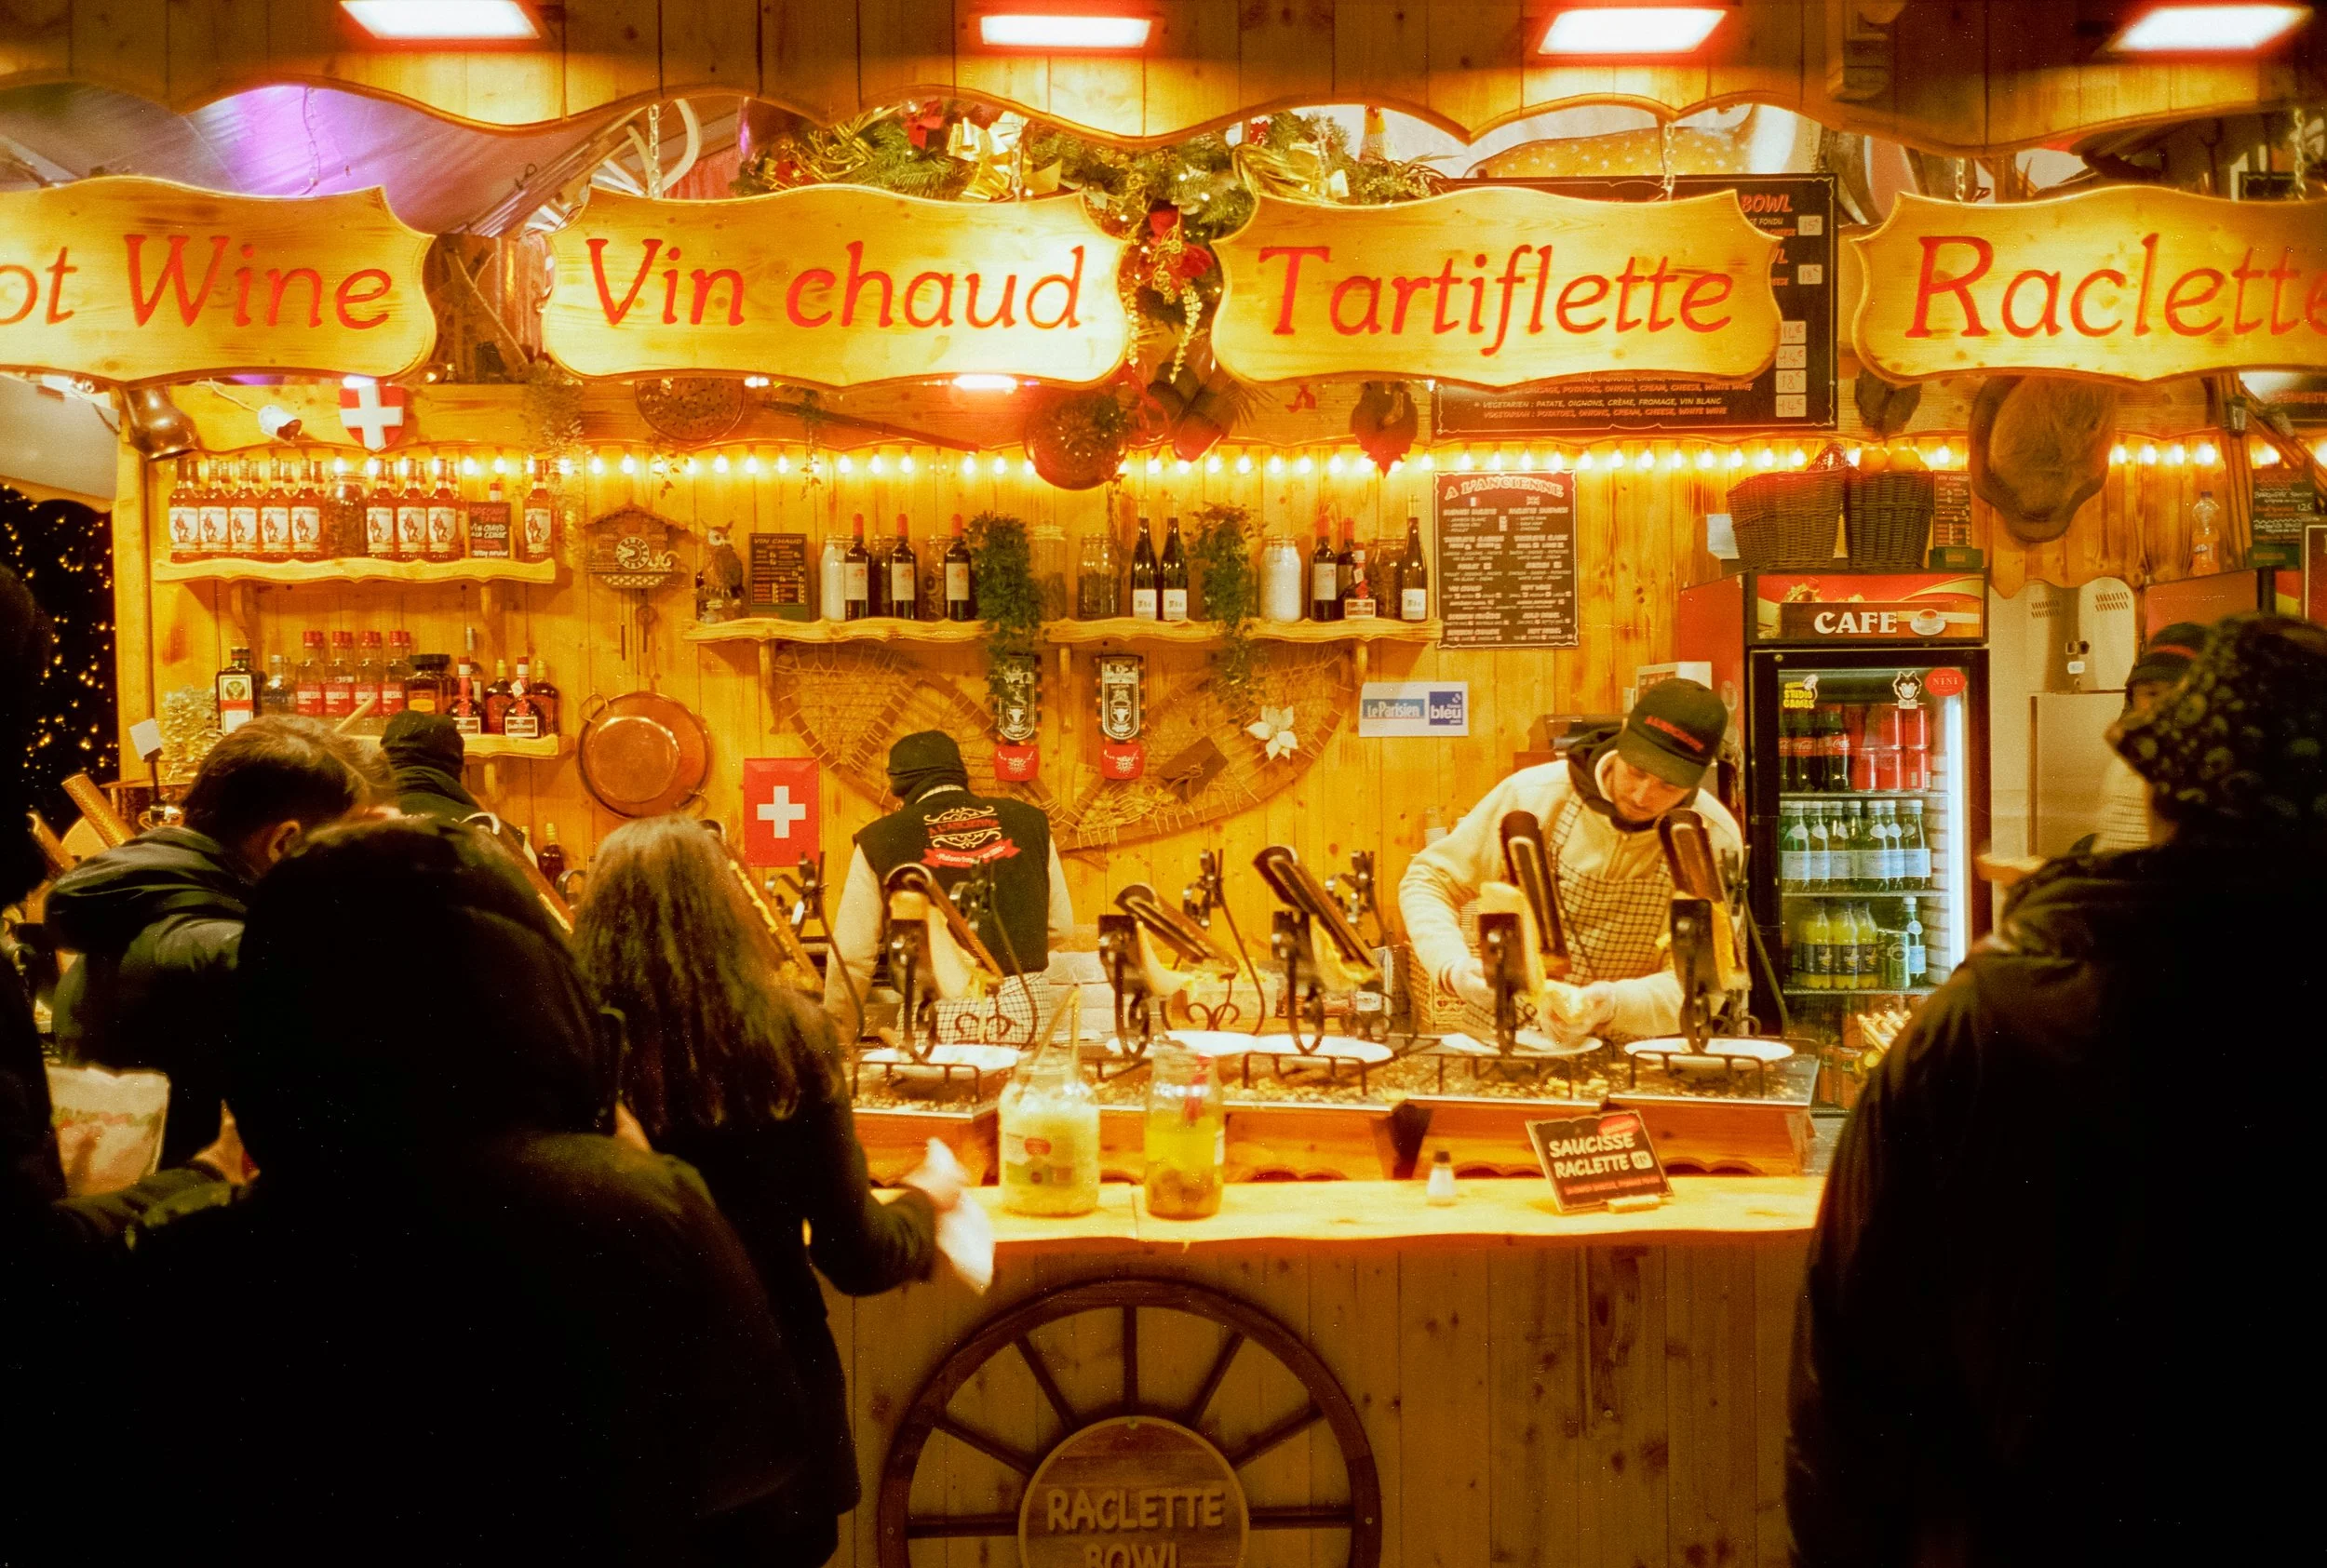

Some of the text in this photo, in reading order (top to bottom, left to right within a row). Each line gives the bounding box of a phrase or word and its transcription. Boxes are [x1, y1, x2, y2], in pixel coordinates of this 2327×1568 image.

[1740, 194, 1794, 213] BOWL
[124, 235, 393, 329] Wine
[585, 238, 1085, 328] Vin chaud
[1258, 244, 1734, 357] Tartiflette
[1567, 399, 1605, 408] OIGNONS,
[1607, 397, 1636, 407] CRÈME,
[1638, 398, 1678, 407] FROMAGE,
[1444, 476, 1565, 502] A L'ANCIENNE
[1813, 611, 1898, 635] CAFE
[1367, 701, 1420, 718] Le Parisien
[1430, 704, 1462, 719] bleu
[1548, 1132, 1636, 1159] SAUCISSE
[1553, 1152, 1631, 1180] RACLETTE
[1046, 1487, 1226, 1531] RACLETTE
